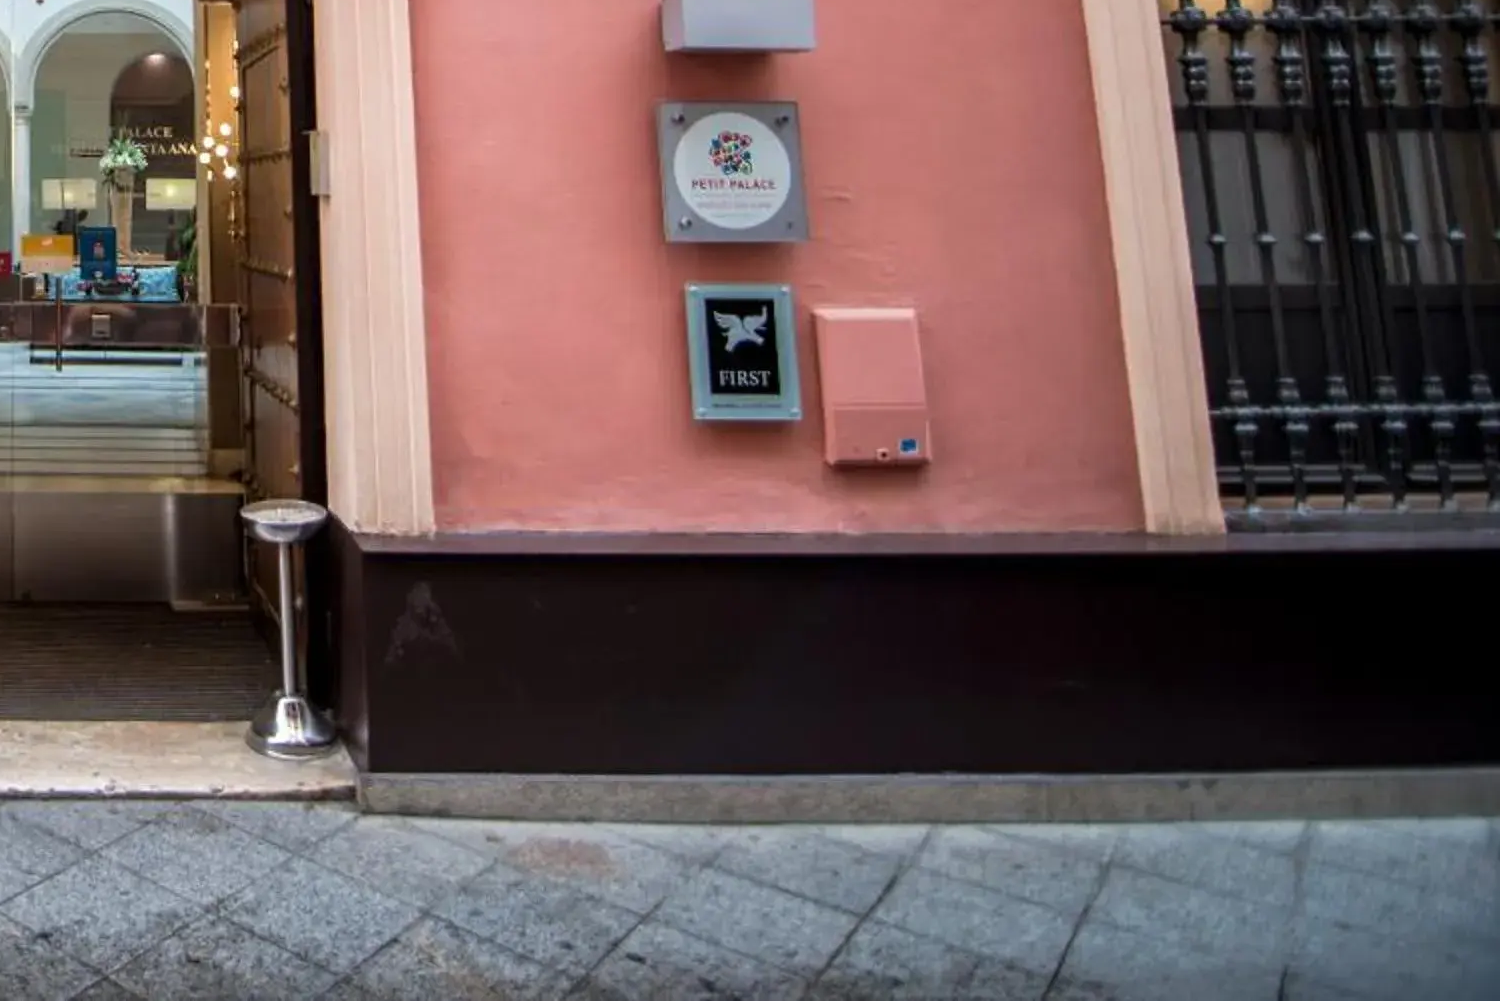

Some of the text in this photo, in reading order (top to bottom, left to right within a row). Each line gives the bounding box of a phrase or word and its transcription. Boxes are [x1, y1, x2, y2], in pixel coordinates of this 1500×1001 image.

[691, 179, 777, 191] PETIT PALACE
[719, 370, 771, 387] FIRST
